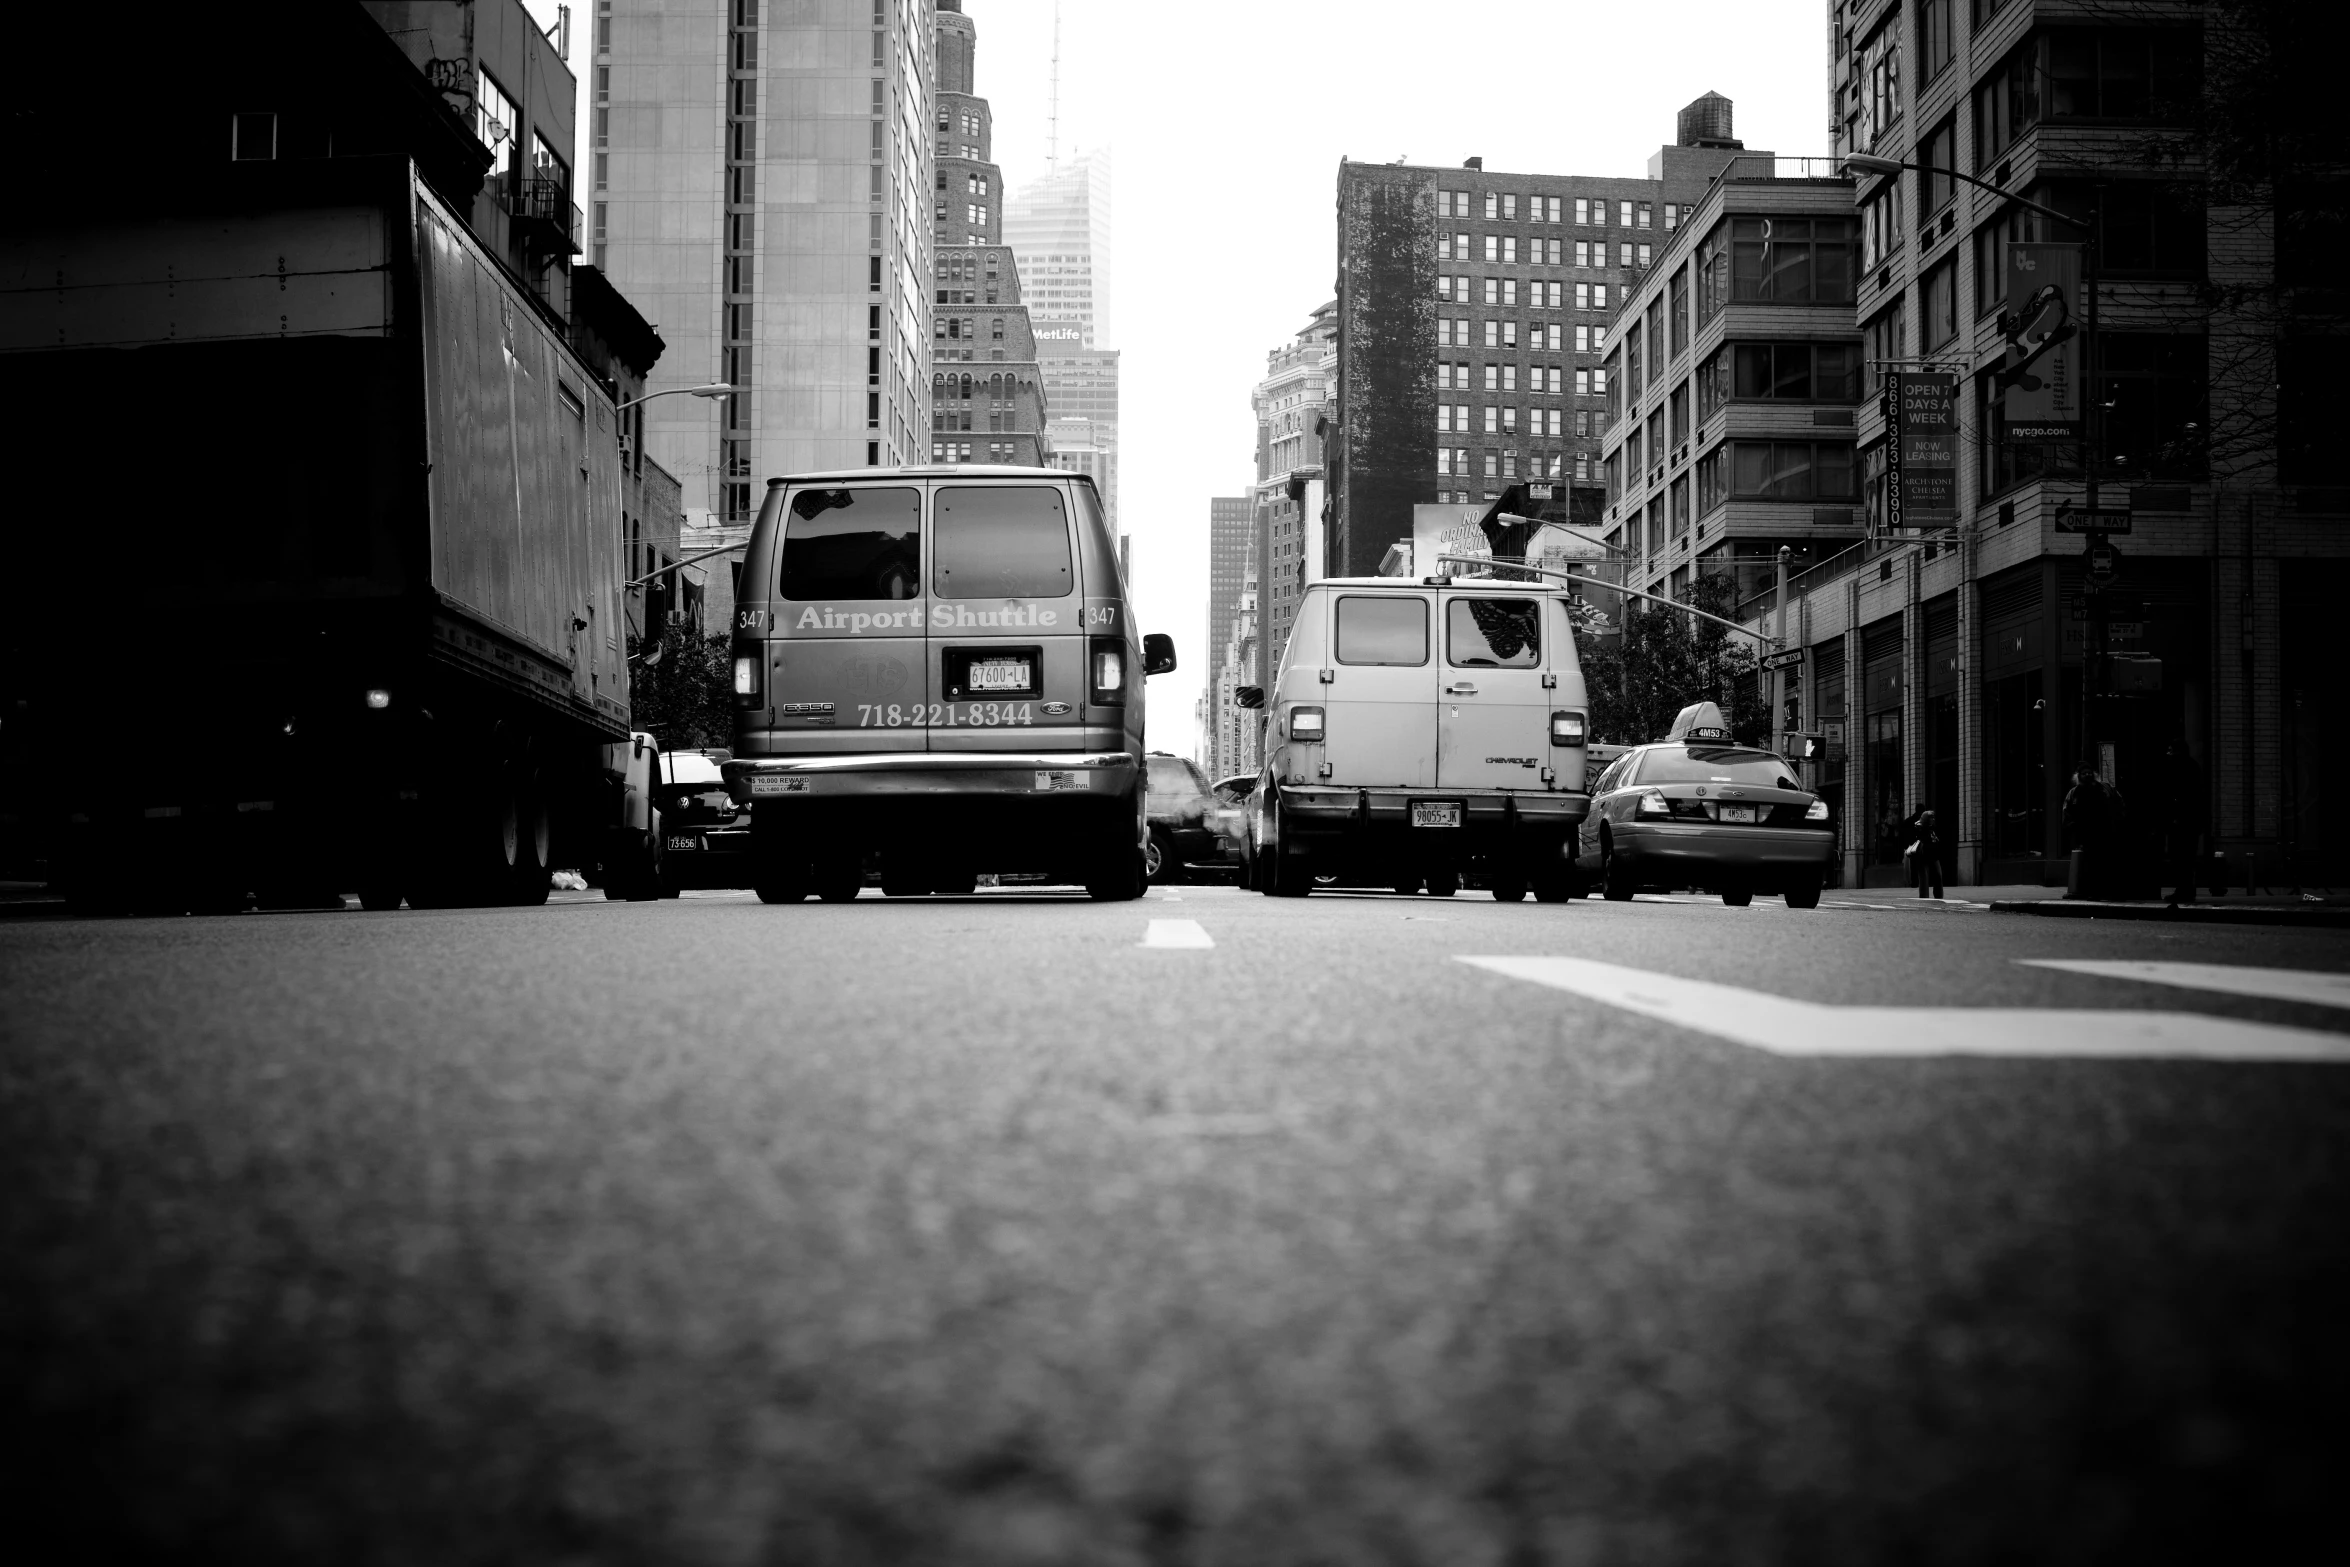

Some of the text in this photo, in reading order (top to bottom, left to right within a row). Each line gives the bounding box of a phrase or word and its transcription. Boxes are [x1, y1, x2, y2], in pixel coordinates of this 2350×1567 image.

[1033, 328, 1080, 340] MetLife
[1905, 385, 1950, 396] OPEN 7
[1905, 399, 1951, 410] DAYS A
[1909, 413, 1946, 424] WEEK
[2013, 428, 2070, 437] nycgo.com
[1916, 442, 1940, 451] NOW
[1906, 452, 1950, 461] LEASING
[1462, 510, 1480, 525] NO
[2068, 515, 2126, 526] ONE WAY
[2074, 598, 2087, 607] M5
[797, 604, 1057, 633] Airport Shuttle
[1089, 607, 1115, 625] 347
[2074, 609, 2088, 619] M7
[740, 611, 765, 629] 347
[1767, 652, 1799, 667] ONE WAY
[857, 703, 1033, 726] 718-221-8344
[1698, 728, 1720, 738] 4M53
[670, 839, 695, 848] 73-656
